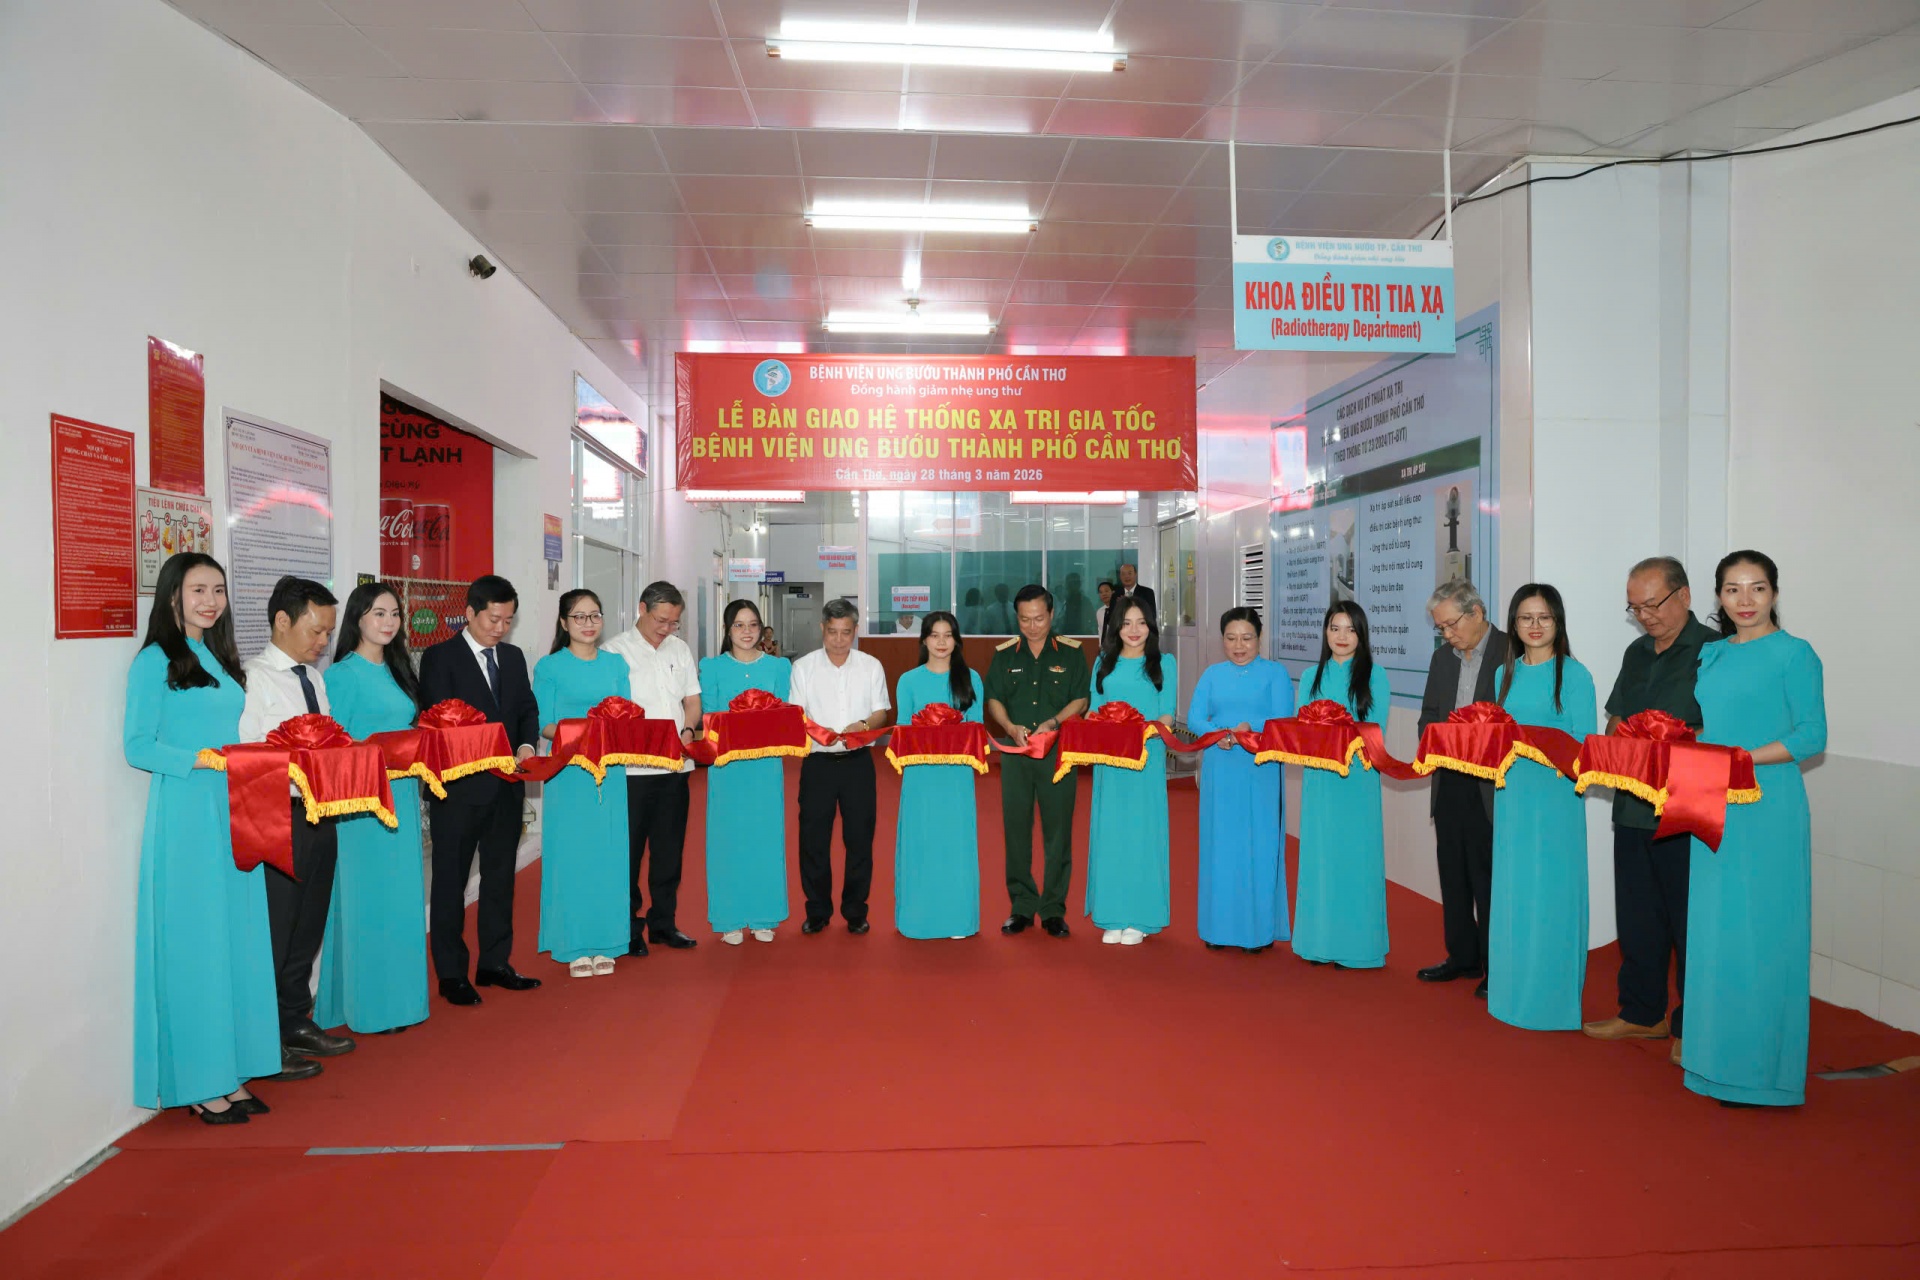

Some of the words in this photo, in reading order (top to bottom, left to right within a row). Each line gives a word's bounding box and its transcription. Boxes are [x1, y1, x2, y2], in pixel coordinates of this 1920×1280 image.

[1245, 281, 1296, 311] KHOA
[1302, 271, 1345, 312] ĐIỀU
[1351, 282, 1381, 319] TRỊ
[1386, 284, 1416, 313] TIA
[1421, 285, 1444, 320] XẠ
[1271, 317, 1350, 342] (Radiotherapy
[1353, 319, 1422, 343] Department)
[810, 364, 843, 383] BỆNH
[846, 364, 874, 383] VIỆN
[877, 366, 903, 381] UNG
[904, 365, 941, 381] BƯỚU
[943, 365, 985, 381] THÀNH
[987, 364, 1013, 381] PHỐ
[1015, 365, 1040, 381] CẦN
[1042, 367, 1068, 381] THƠ
[851, 384, 883, 397] Đồng
[886, 384, 916, 396] hành
[918, 384, 949, 397] giảm
[951, 385, 973, 397] nhẹ
[976, 387, 1000, 398] ung
[1001, 386, 1023, 396] thư
[718, 399, 744, 429] LỄ
[752, 402, 798, 429] BÀN
[805, 407, 859, 429] GIAO
[868, 403, 898, 433] HỆ
[905, 401, 981, 430] THỐNG
[988, 409, 1018, 434] XẠ
[1024, 409, 1060, 434] TRỊ
[1068, 409, 1106, 431] GIA
[1112, 403, 1156, 431] TỐC
[400, 446, 462, 467] LẠNH
[692, 432, 753, 463] BỆNH
[761, 432, 814, 463] VIỆN
[823, 437, 869, 459] UNG
[877, 433, 939, 459] BƯỚU
[948, 433, 1023, 459] THÀNH
[1031, 431, 1077, 460] PHỐ
[1085, 432, 1129, 460] CẦN
[1137, 436, 1182, 460] THƠ
[835, 467, 858, 481] Cần
[889, 470, 917, 482] ngày
[920, 469, 935, 481] 28
[939, 469, 971, 482] tháng
[975, 469, 983, 480] 3
[986, 469, 1010, 481] năm
[1013, 469, 1043, 481] 2026
